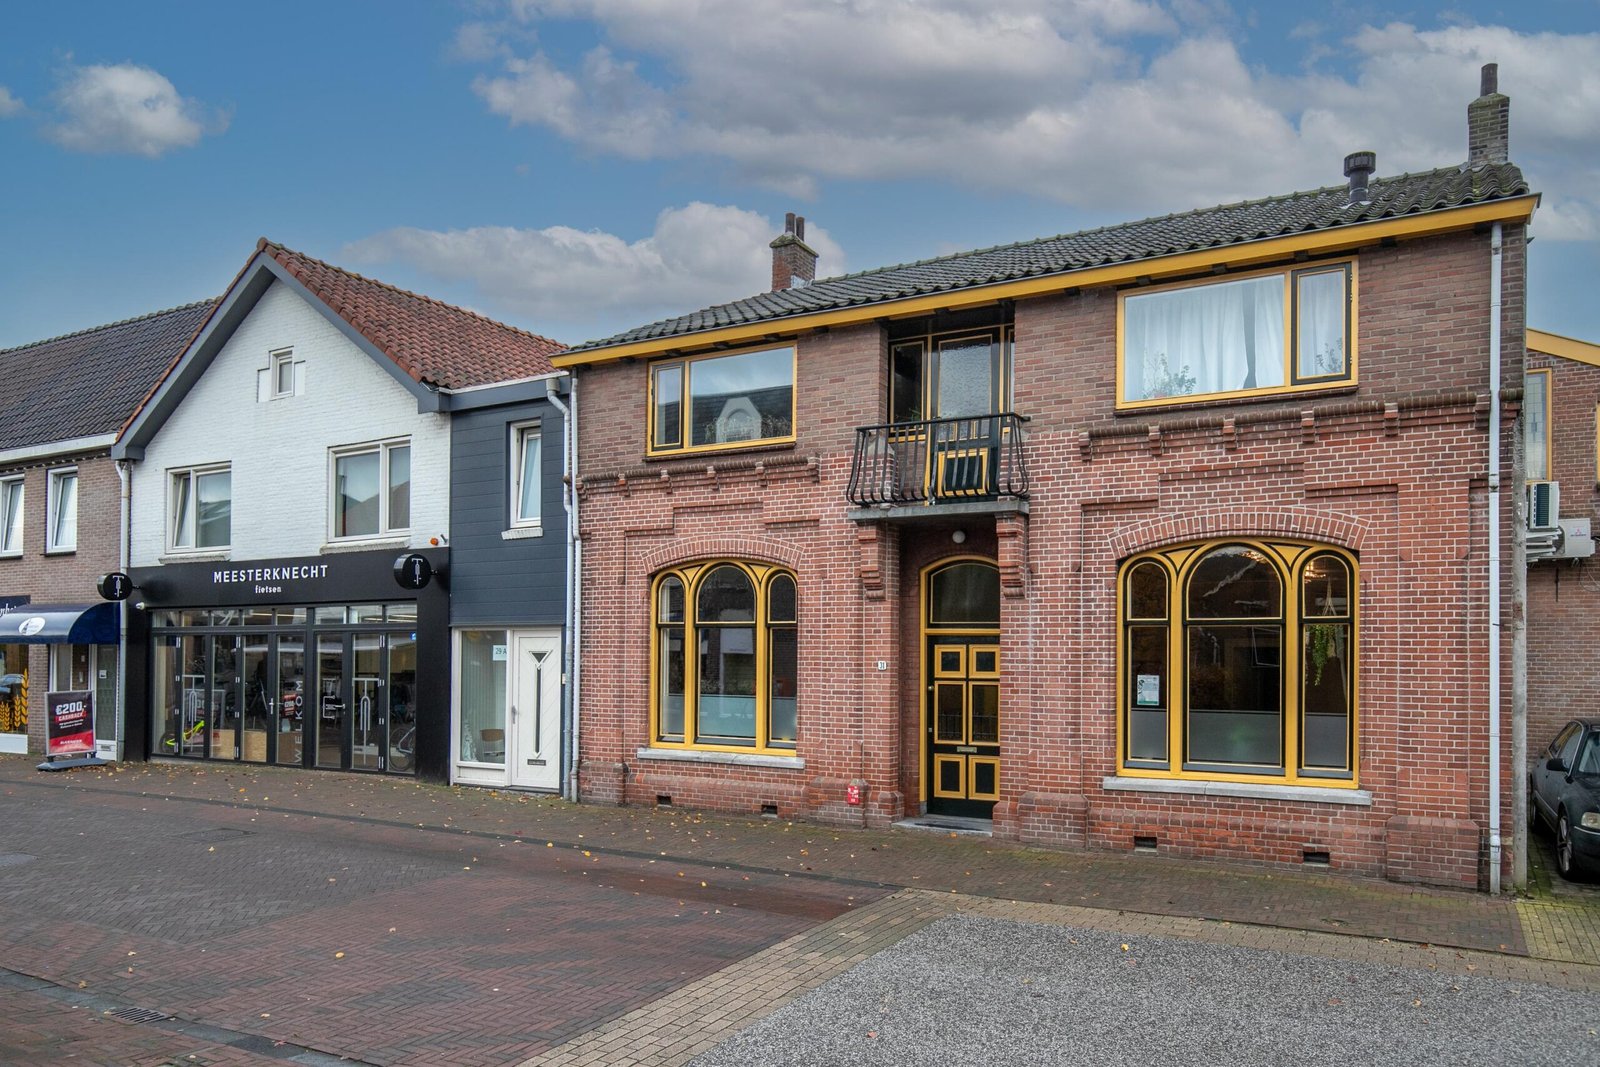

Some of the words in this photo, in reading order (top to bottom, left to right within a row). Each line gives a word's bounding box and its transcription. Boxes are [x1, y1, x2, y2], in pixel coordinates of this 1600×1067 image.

[213, 564, 328, 583] MEESTERKNECHT
[255, 585, 282, 594] fietsen
[295, 680, 303, 762] WELKOM
